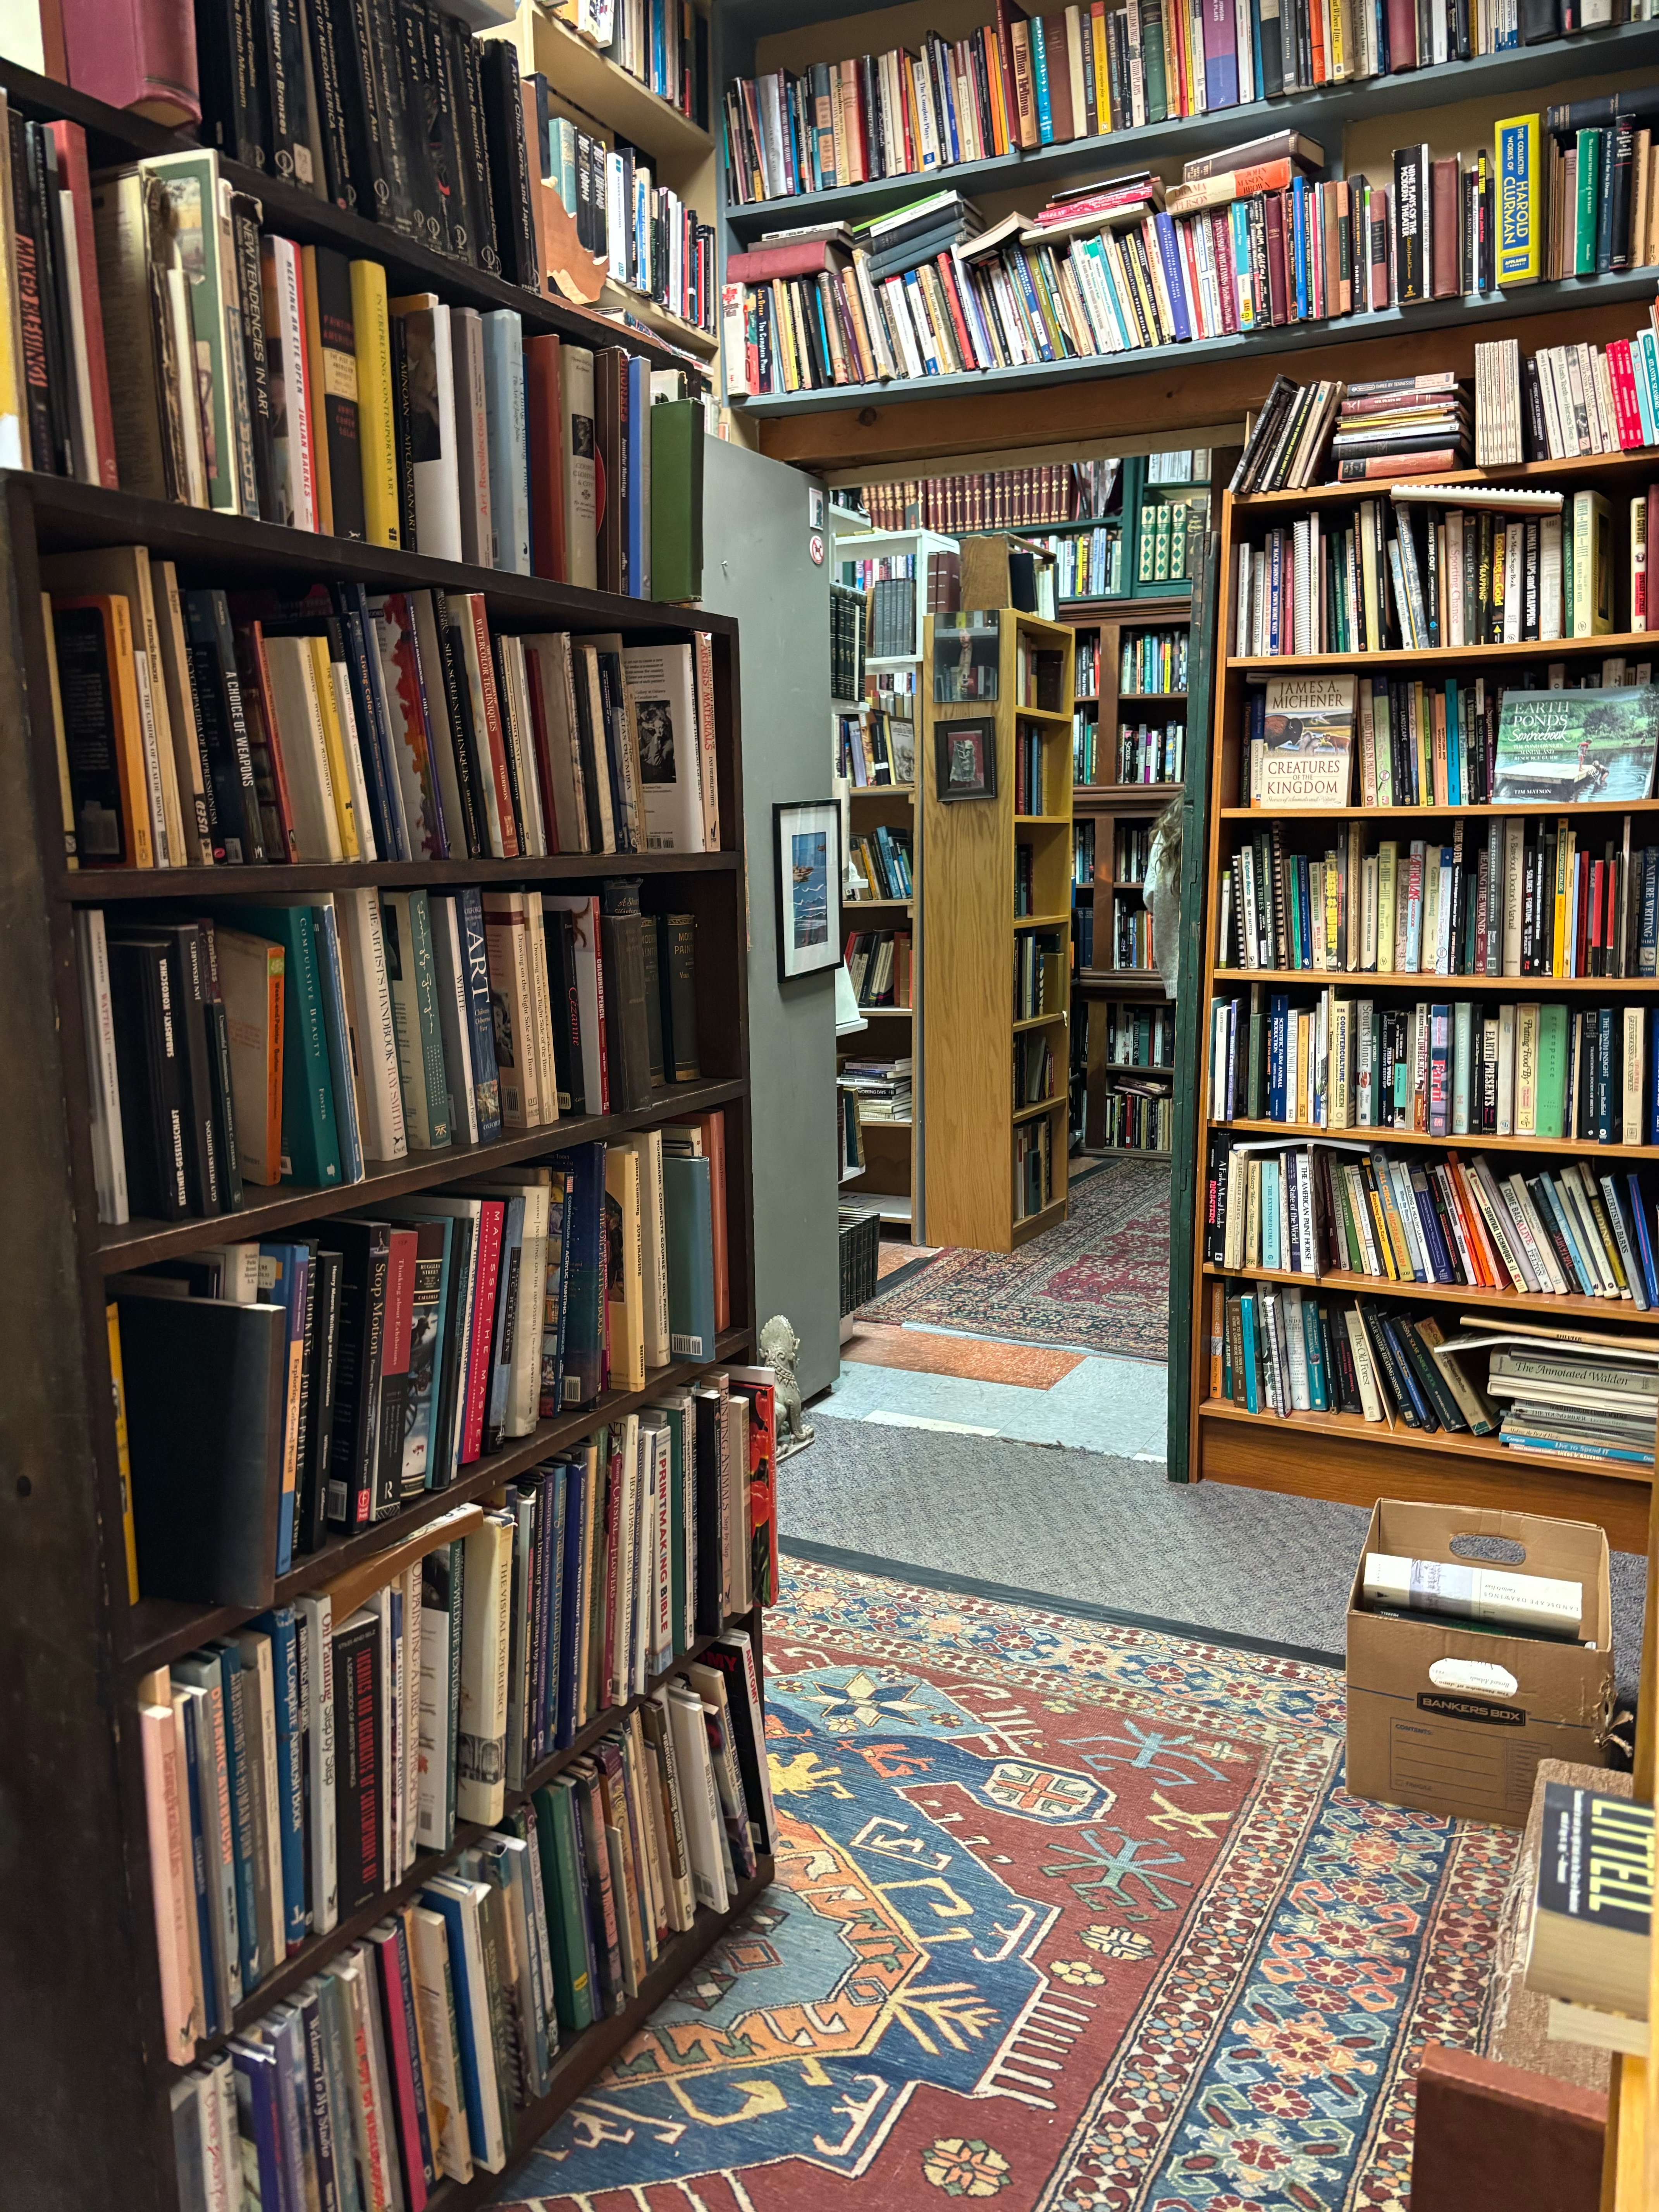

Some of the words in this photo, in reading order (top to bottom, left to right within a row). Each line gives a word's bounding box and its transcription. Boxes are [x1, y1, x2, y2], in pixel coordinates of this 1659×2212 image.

[272, 9, 281, 57] History
[276, 62, 284, 77] of
[434, 34, 447, 113] Mondrian
[276, 79, 286, 134] Bronzes
[1237, 175, 1263, 186] MASON
[1245, 168, 1267, 178] JOHN
[1508, 161, 1514, 171] OF
[1244, 184, 1270, 193] BROWN
[1409, 207, 1416, 217] OF
[1503, 177, 1516, 245] CLURMAN
[1516, 181, 1528, 237] HAROLD
[242, 218, 255, 259] NEW
[1505, 256, 1526, 265] APPLAUSE
[286, 260, 296, 311] KEEPING
[246, 262, 265, 362] TENDENCIES
[291, 316, 299, 328] AN
[292, 337, 301, 358] EYE
[376, 293, 387, 378] INTERPRETING
[255, 365, 266, 384] IN
[295, 363, 303, 394] OPEN
[400, 362, 411, 416] MINOAN
[257, 387, 269, 418] ART
[298, 408, 308, 448] JULIAN
[381, 379, 394, 473] CONTEMPORARY
[301, 452, 311, 497] BARNES
[404, 434, 415, 507] MYCENAEAN
[1494, 533, 1505, 570] Looking
[1528, 524, 1537, 550] ANIMAL
[1451, 549, 1460, 589] Sporting
[1494, 573, 1502, 583] for
[1527, 551, 1537, 575] TRAPS
[1479, 563, 1490, 600] TRAPPING
[1494, 583, 1504, 606] Gold
[1527, 576, 1535, 589] and
[1452, 591, 1461, 623] Chance
[1526, 590, 1537, 626] TRAPPING
[225, 671, 237, 679] A
[476, 618, 489, 676] WATERCOLOR
[483, 676, 497, 732] TECHNIQUES
[1280, 681, 1323, 695] JAMES
[1329, 680, 1339, 692] A.
[227, 681, 239, 719] CHOICE
[1273, 695, 1344, 709] MICHENER
[1514, 702, 1569, 714] EARTH
[233, 720, 243, 733] OF
[1508, 726, 1573, 743] Sourcebook
[1513, 714, 1568, 727] PONDS
[235, 736, 254, 787] WEAPONS
[1268, 760, 1340, 774] CREATURES
[499, 765, 509, 800] HARRISON
[1267, 781, 1338, 795] KINGDOM
[1409, 854, 1422, 901] EARTHQUAKE
[1646, 865, 1656, 897] NATURE
[368, 900, 379, 925] THE
[464, 906, 482, 914] OXFORD
[1478, 901, 1487, 934] WOUNDS
[1644, 899, 1655, 937] WRITING
[371, 930, 385, 985] ARTIST'S
[466, 930, 490, 1003] ART
[158, 959, 170, 1011] KOKOSCHKA
[300, 917, 314, 999] COMPULSIVE
[310, 1008, 320, 1058] BEAUTY
[456, 975, 466, 1012] WHITE
[164, 1010, 175, 1058] SABARSKY:
[378, 989, 396, 1061] HANDBOOK
[568, 986, 580, 1046] Cézanne
[1363, 1006, 1372, 1036] Scout's
[1522, 1019, 1533, 1047] Putting
[1486, 1030, 1496, 1059] EARTH
[1523, 1048, 1532, 1070] Food
[387, 1067, 398, 1088] RAY
[1484, 1062, 1495, 1106] PRESENTS
[1522, 1069, 1532, 1085] By
[390, 1091, 402, 1131] SMITH
[483, 1120, 501, 1130] OXFORD
[170, 1108, 187, 1207] KESTNER-GESELLSCHAFT
[1334, 1195, 1343, 1230] PARADISE
[1504, 1188, 1516, 1207] COME
[1511, 1207, 1523, 1225] BACK
[1518, 1222, 1533, 1245] ALIVE
[1603, 1185, 1622, 1233] ADVERTISING
[1617, 1233, 1629, 1254] BARNS
[1291, 1224, 1299, 1244] World
[1388, 1213, 1401, 1243] MICHAEL
[1396, 1245, 1406, 1267] PALIN
[1484, 1206, 1499, 1232] SURVIVAL
[1495, 1232, 1513, 1263] TECHNIQUES
[488, 1211, 499, 1302] MATISSE
[396, 1258, 405, 1295] Thinking
[391, 1321, 401, 1365] Exhibitions
[1516, 1362, 1534, 1373] The
[1536, 1362, 1587, 1379] Annotated
[1588, 1369, 1628, 1385] Walden
[475, 1369, 487, 1453] MASTER
[659, 1458, 668, 1583] PRINTMAKING
[660, 1585, 668, 1632] BIBLE
[1484, 1591, 1526, 1604] DRAWINGS
[1530, 1596, 1579, 1612] LANDSCAPE
[746, 1649, 757, 1705] ANATOMY
[1423, 1698, 1489, 1716] BANKERS
[1490, 1709, 1520, 1721] BOX
[1589, 1799, 1655, 1913] LITTELL
